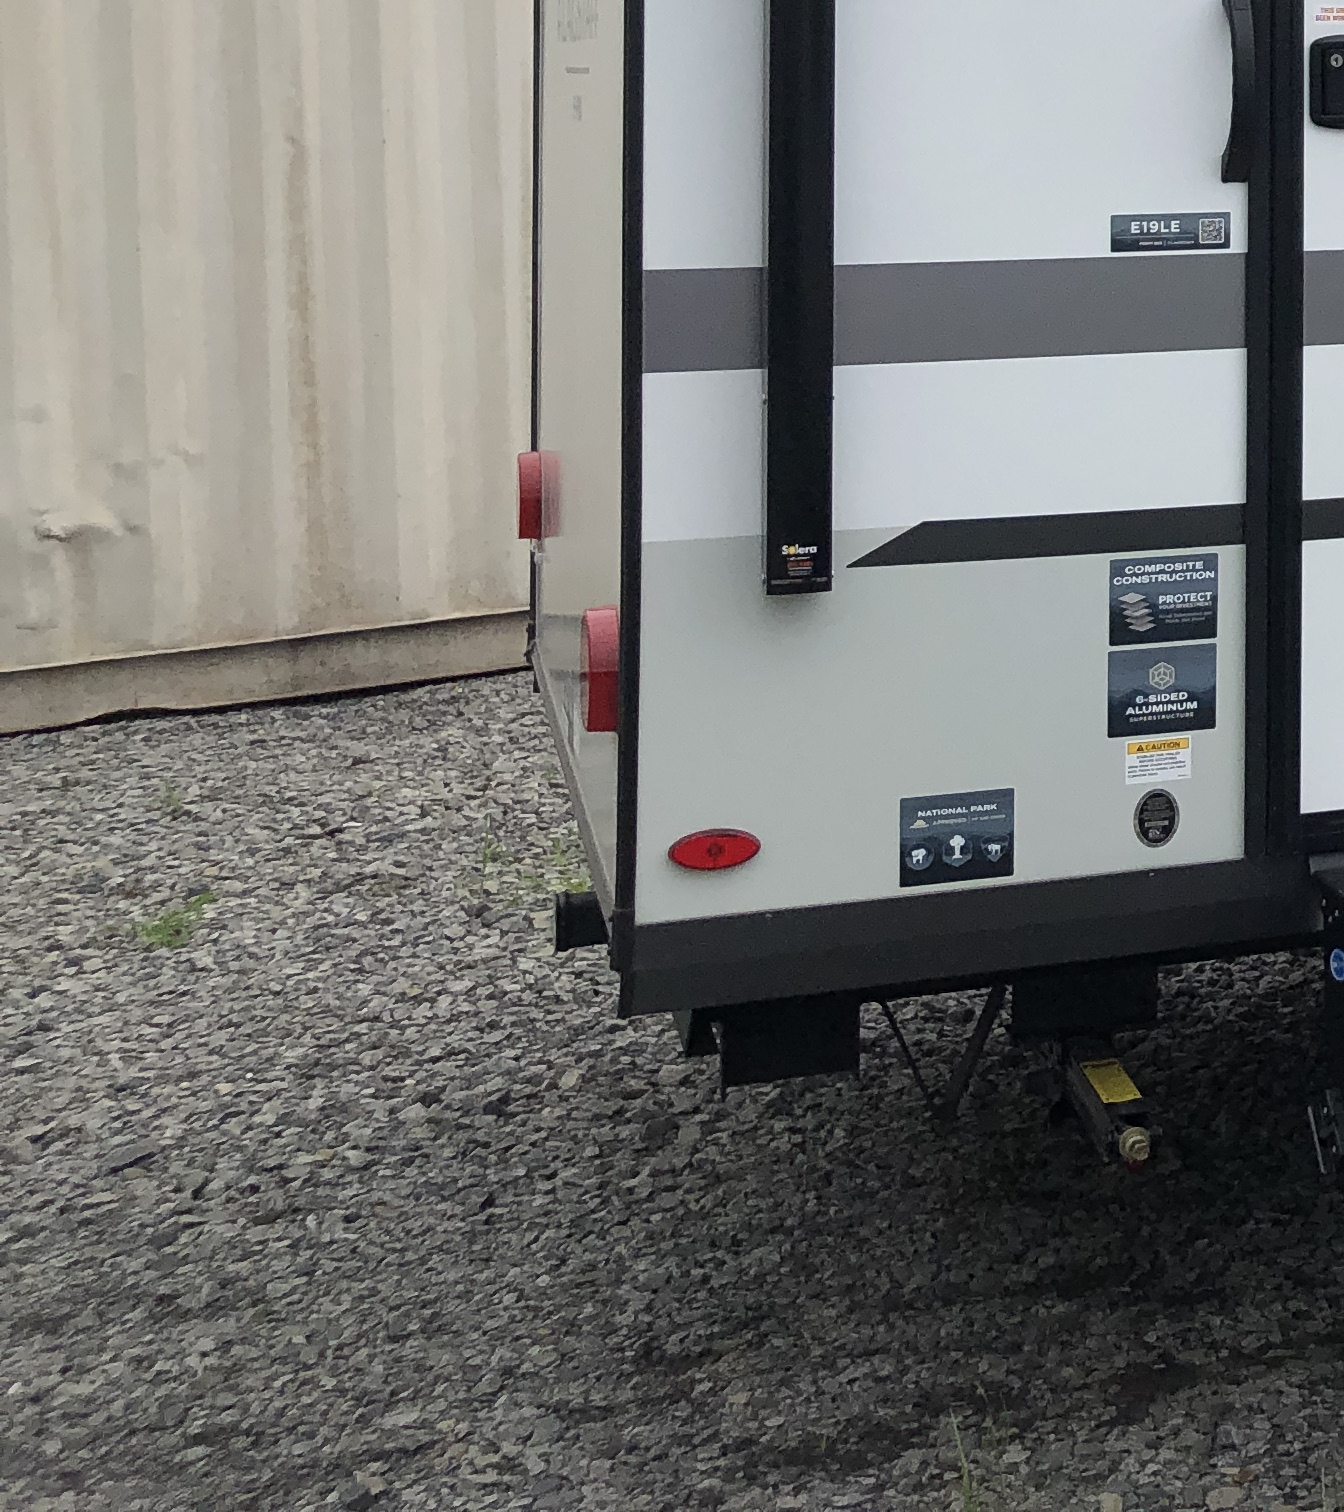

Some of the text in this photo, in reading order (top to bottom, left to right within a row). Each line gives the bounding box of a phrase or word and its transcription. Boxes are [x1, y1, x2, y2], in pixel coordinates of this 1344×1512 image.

[1131, 220, 1180, 234] E19LE
[781, 543, 818, 555] Solera
[1124, 561, 1204, 575] COMPOSITE
[1113, 570, 1215, 586] CONSTRUCTION
[1158, 591, 1213, 605] PROTECT
[1135, 691, 1188, 704] 6-SIDED
[1125, 701, 1198, 716] ALUMINUM
[1145, 741, 1181, 751] CAUTION
[917, 806, 969, 818] NATIONAL
[970, 803, 998, 813] PARK
